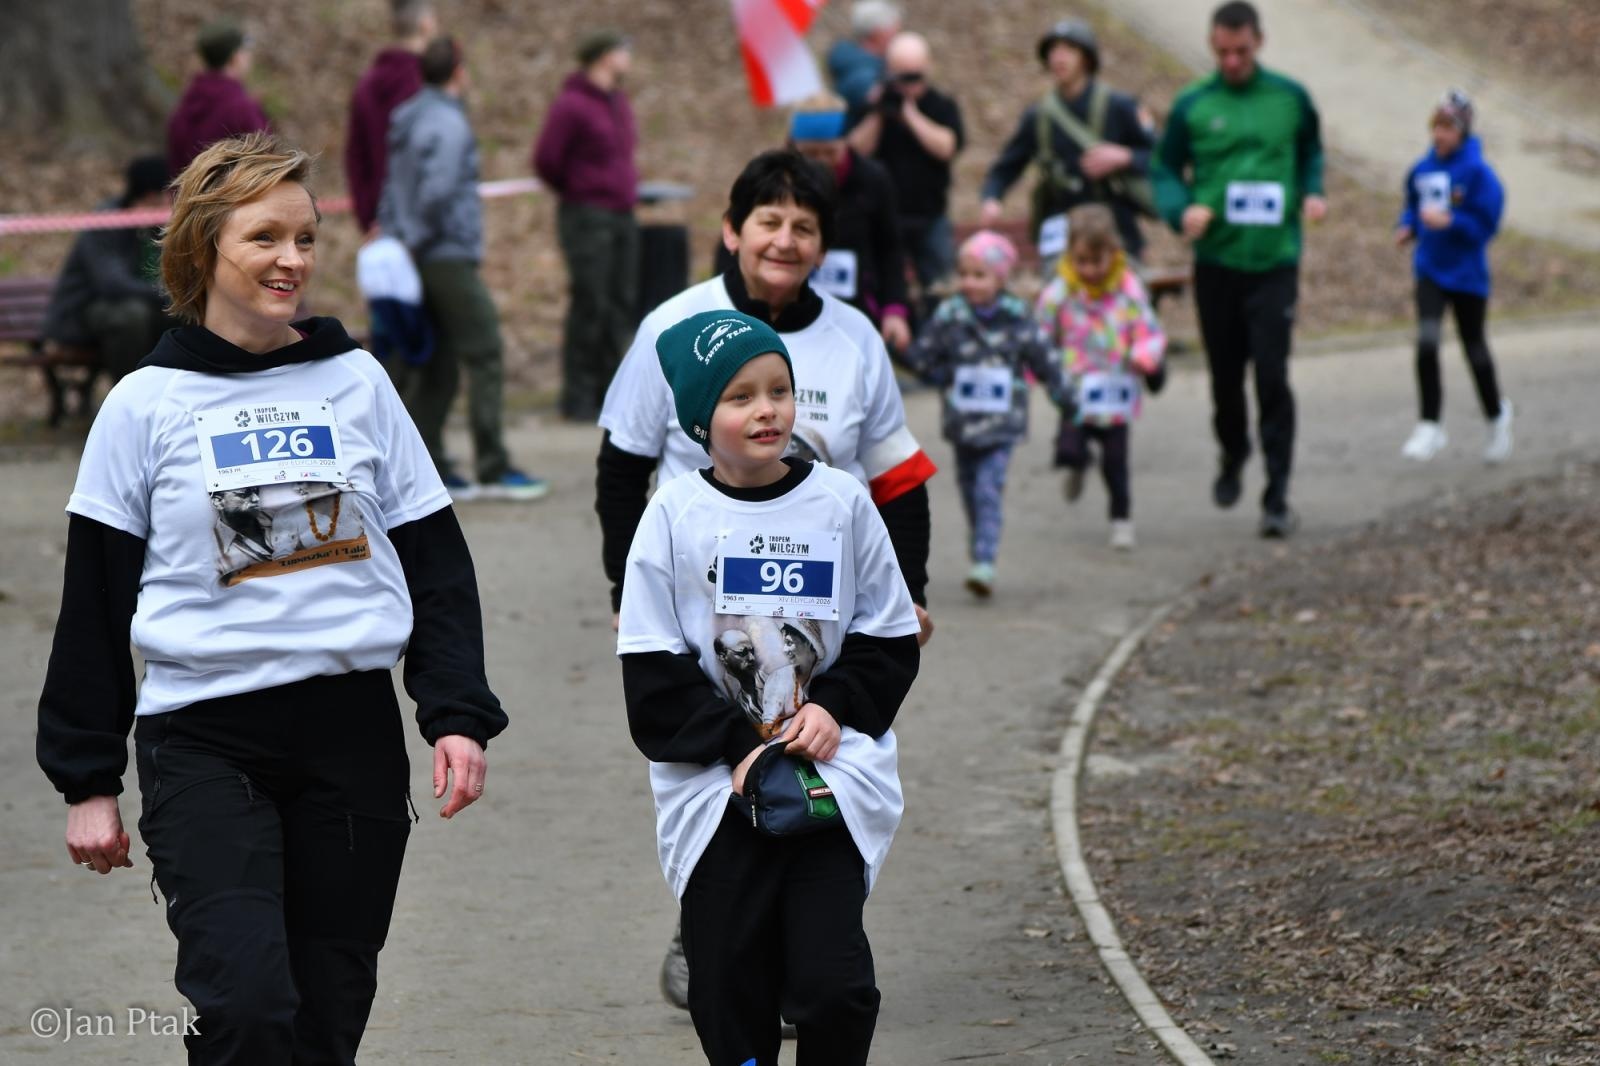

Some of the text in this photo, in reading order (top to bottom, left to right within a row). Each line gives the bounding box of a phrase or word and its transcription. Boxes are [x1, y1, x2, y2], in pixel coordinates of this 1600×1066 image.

[704, 339, 725, 365] SWIM
[726, 325, 753, 340] TEAM
[256, 411, 301, 424] WILCZYM
[240, 428, 314, 461] 126
[768, 535, 791, 543] TROPEM
[768, 543, 810, 554] WILCZYM
[760, 560, 805, 594] 96
